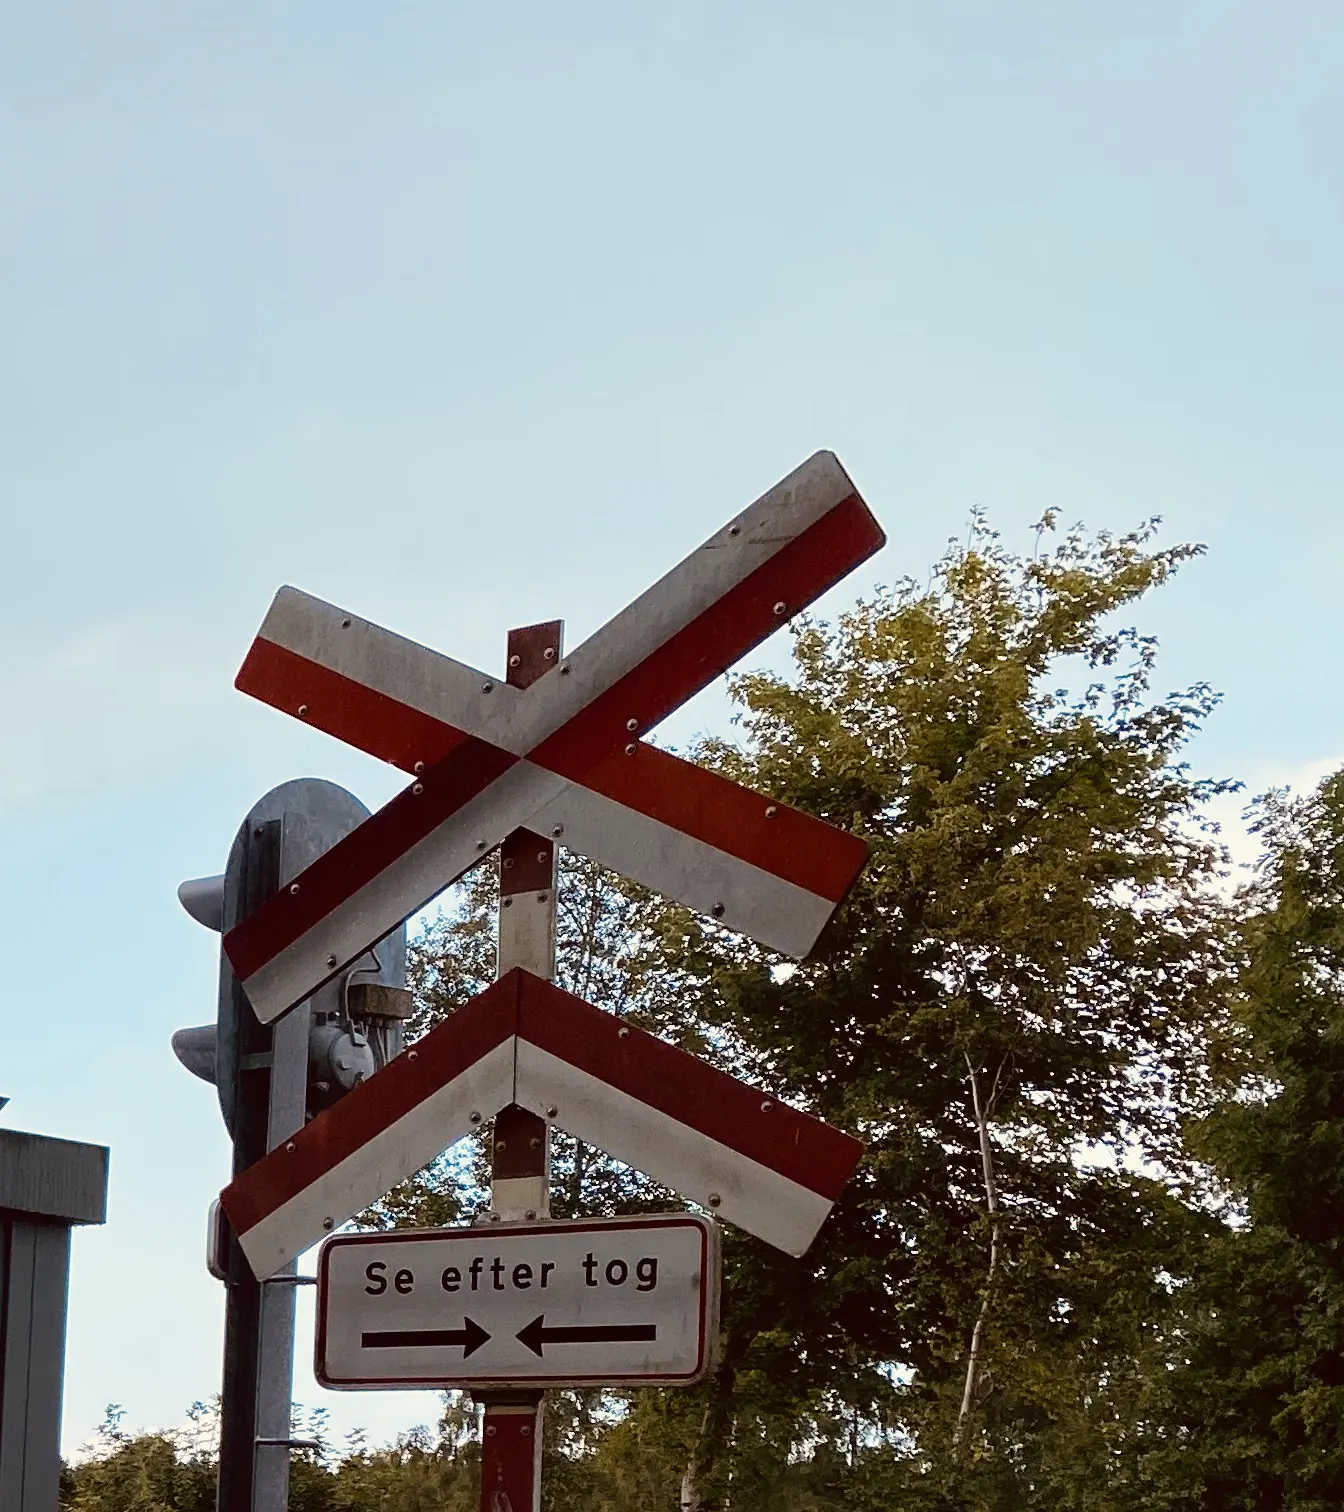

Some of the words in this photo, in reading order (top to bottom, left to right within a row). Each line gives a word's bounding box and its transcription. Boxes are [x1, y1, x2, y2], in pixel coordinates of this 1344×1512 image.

[364, 1261, 414, 1295] Se
[441, 1256, 555, 1292] efter
[582, 1251, 658, 1292] tog
